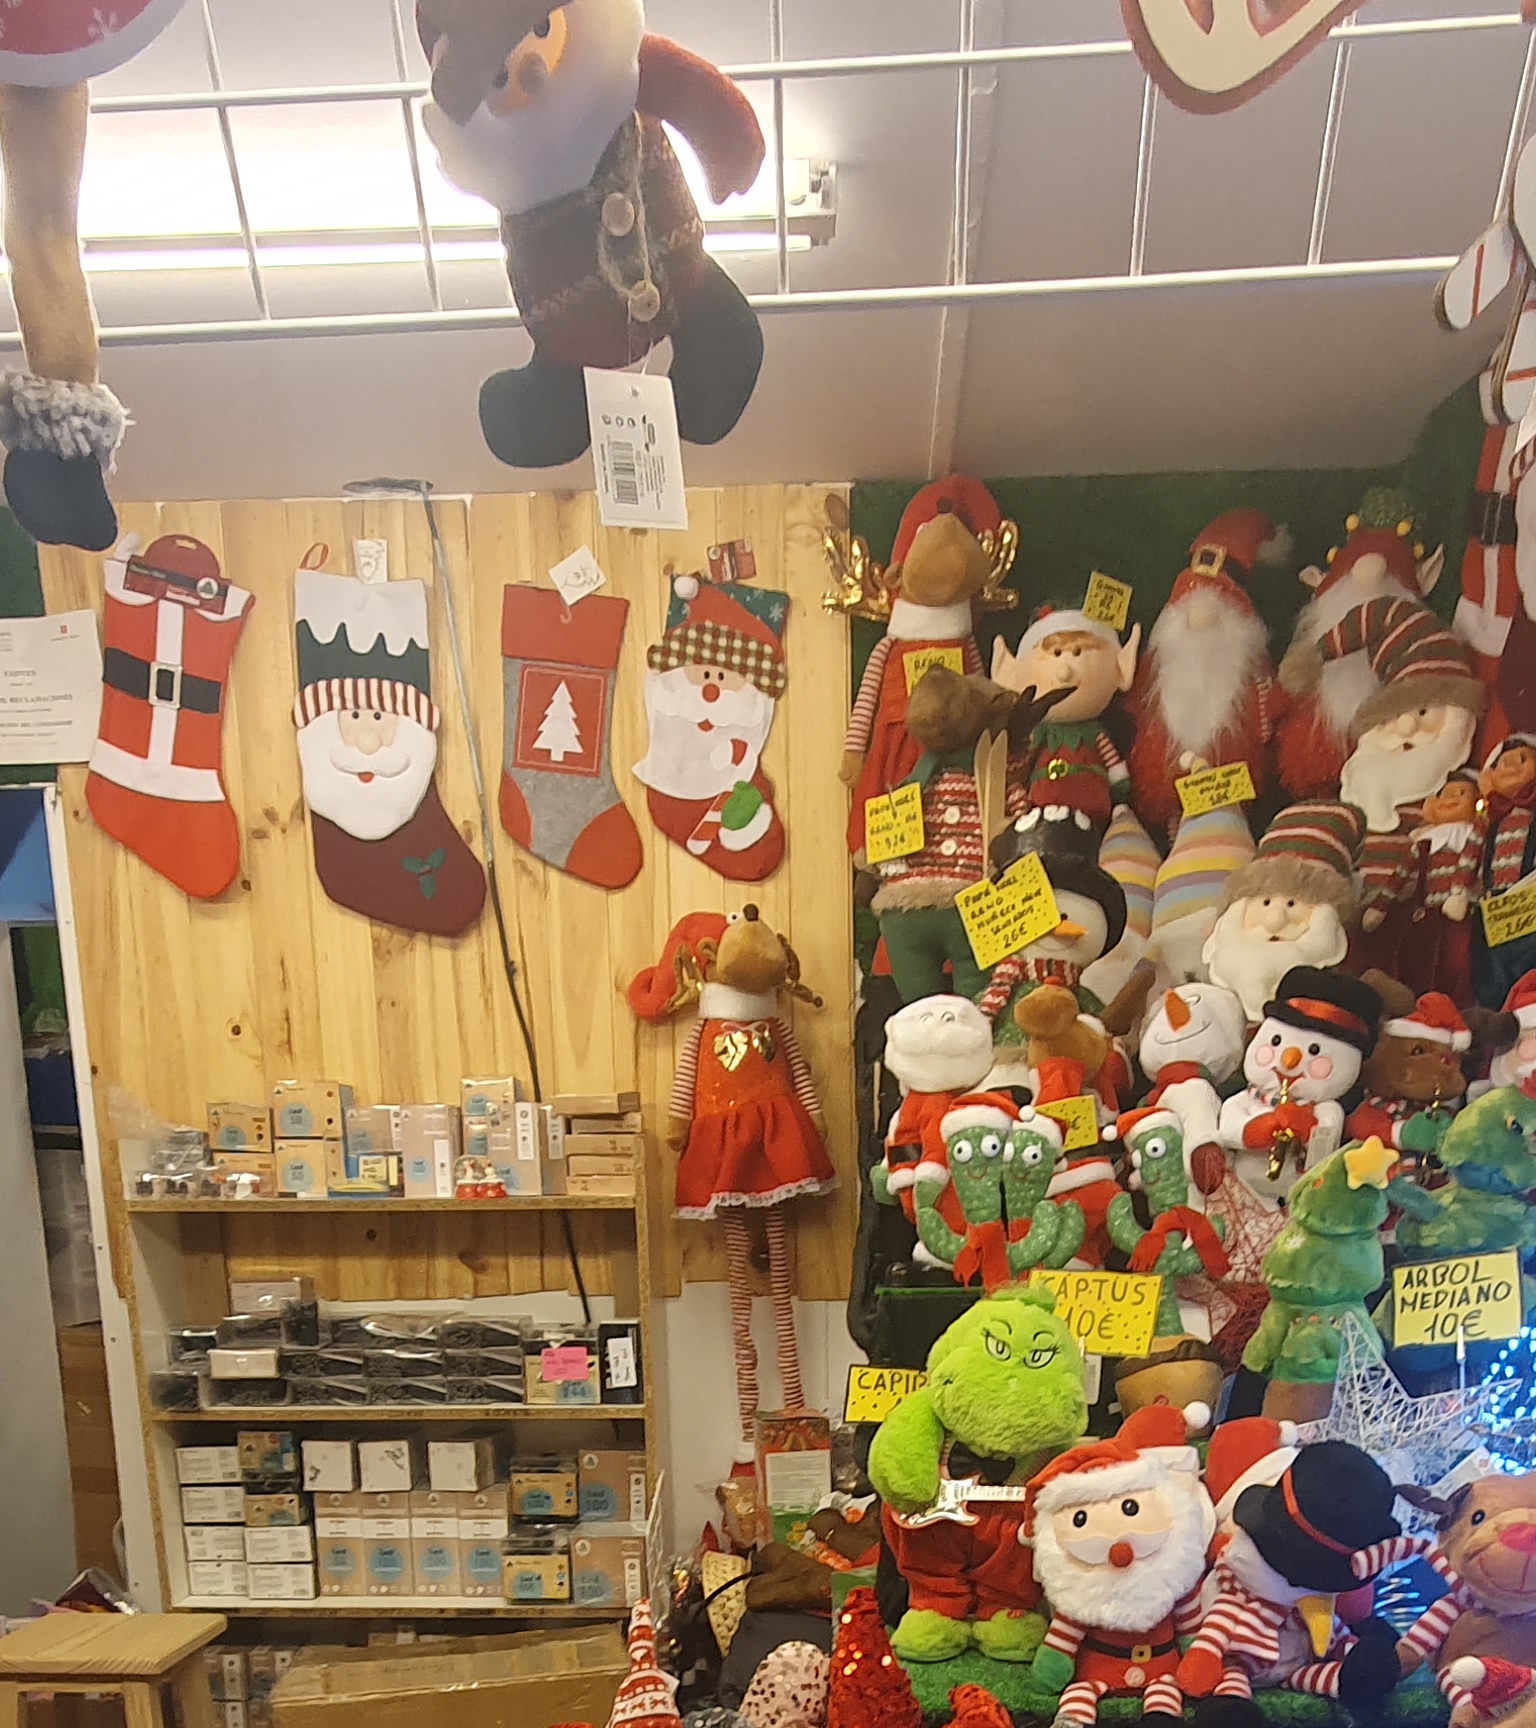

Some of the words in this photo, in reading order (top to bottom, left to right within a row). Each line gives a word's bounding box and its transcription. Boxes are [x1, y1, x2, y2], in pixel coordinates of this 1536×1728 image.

[1402, 1259, 1492, 1291] ARBOL
[1400, 1280, 1512, 1315] MEDIANO
[1423, 1308, 1486, 1342] 10€
